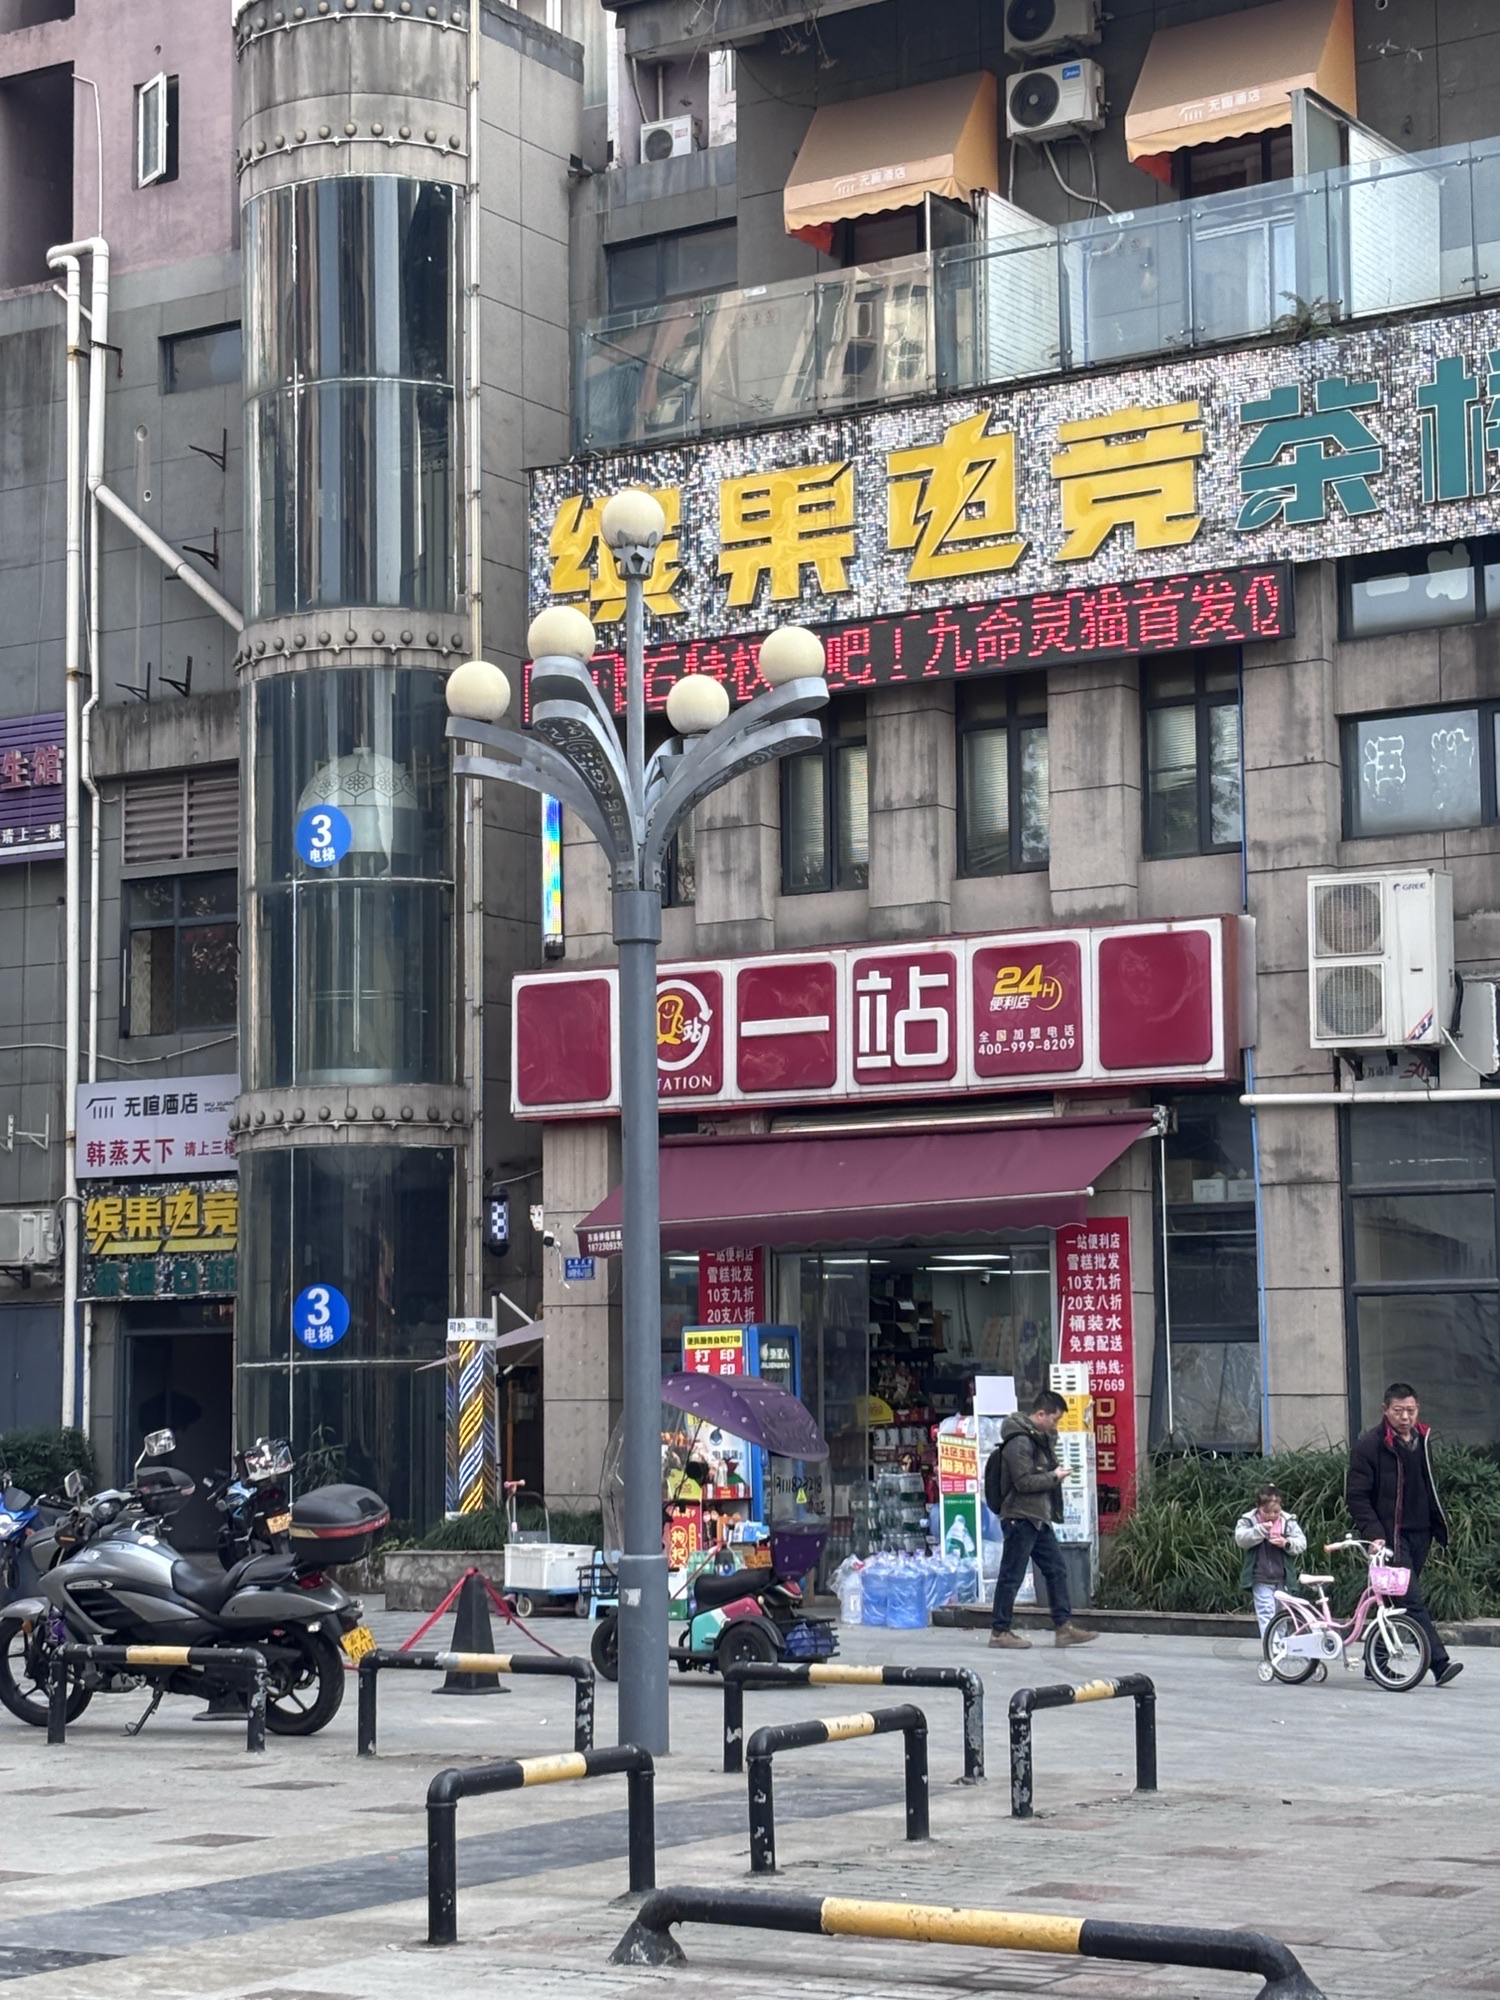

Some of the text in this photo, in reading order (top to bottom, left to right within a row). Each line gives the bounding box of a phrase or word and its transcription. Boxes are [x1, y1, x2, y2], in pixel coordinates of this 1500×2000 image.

[1, 823, 62, 844] 请上二楼
[311, 814, 332, 848] 3
[309, 846, 336, 863] 电梯
[1402, 881, 1427, 891] GREE
[989, 995, 1031, 1012] 便利店
[740, 965, 950, 1070] 一站
[978, 1023, 1075, 1044] 全国加盟电话
[978, 1037, 1076, 1056] 400-999-8209
[124, 1092, 198, 1118] 无喧酒店
[86, 1138, 175, 1167] 韩蒸天下
[184, 1139, 236, 1156] 请上三楼
[84, 1188, 238, 1254] 缤果电竞
[1066, 1234, 1120, 1249] 一站便利店
[1067, 1254, 1120, 1270] 雪糕批发
[707, 1265, 753, 1284] 雪糕批发
[1067, 1274, 1121, 1291] 10支九折
[707, 1286, 754, 1303] 10支九折
[1067, 1295, 1122, 1311] 20支八折
[307, 1288, 330, 1326] 3
[707, 1306, 755, 1324] 20支八折
[1069, 1315, 1122, 1332] 桶装水
[304, 1326, 334, 1343] 电梯
[1069, 1335, 1123, 1352] 免费配送
[694, 1349, 735, 1362] 打印
[1096, 1398, 1117, 1472] 口味王
[941, 1458, 977, 1477] 服务站
